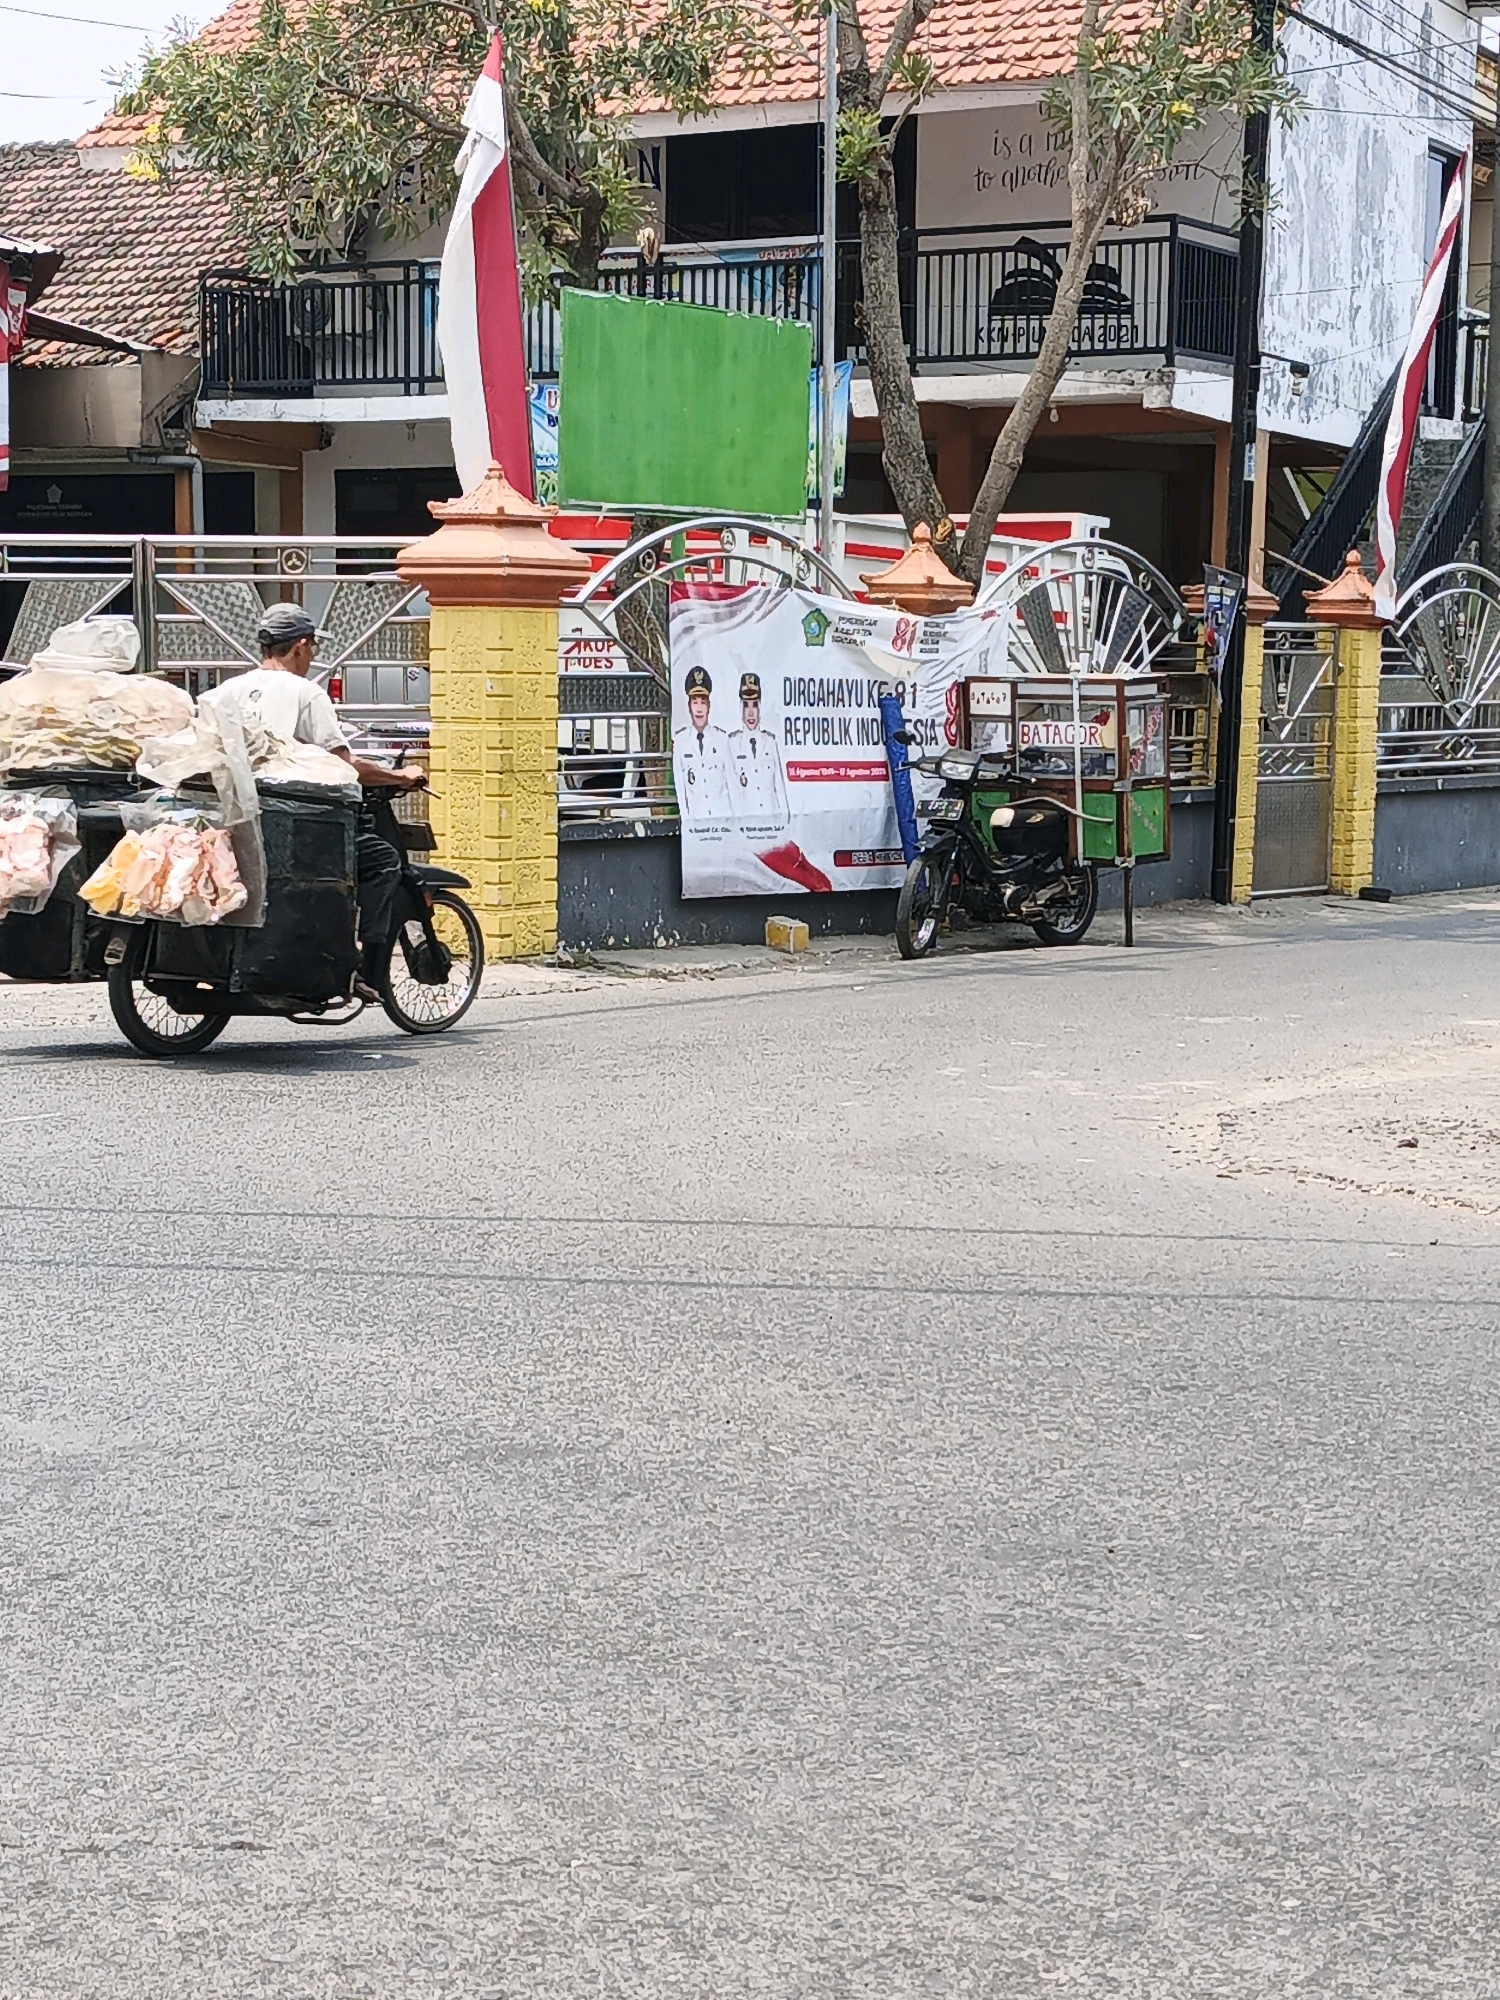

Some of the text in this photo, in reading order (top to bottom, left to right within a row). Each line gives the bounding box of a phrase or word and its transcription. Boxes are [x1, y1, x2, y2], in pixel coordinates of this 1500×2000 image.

[993, 129, 1013, 160] is
[1019, 131, 1033, 158] a
[973, 164, 996, 192] to
[1001, 156, 1072, 193] anothe
[783, 676, 864, 708] DIRGAHAYU
[784, 716, 853, 746] REPUBLIK
